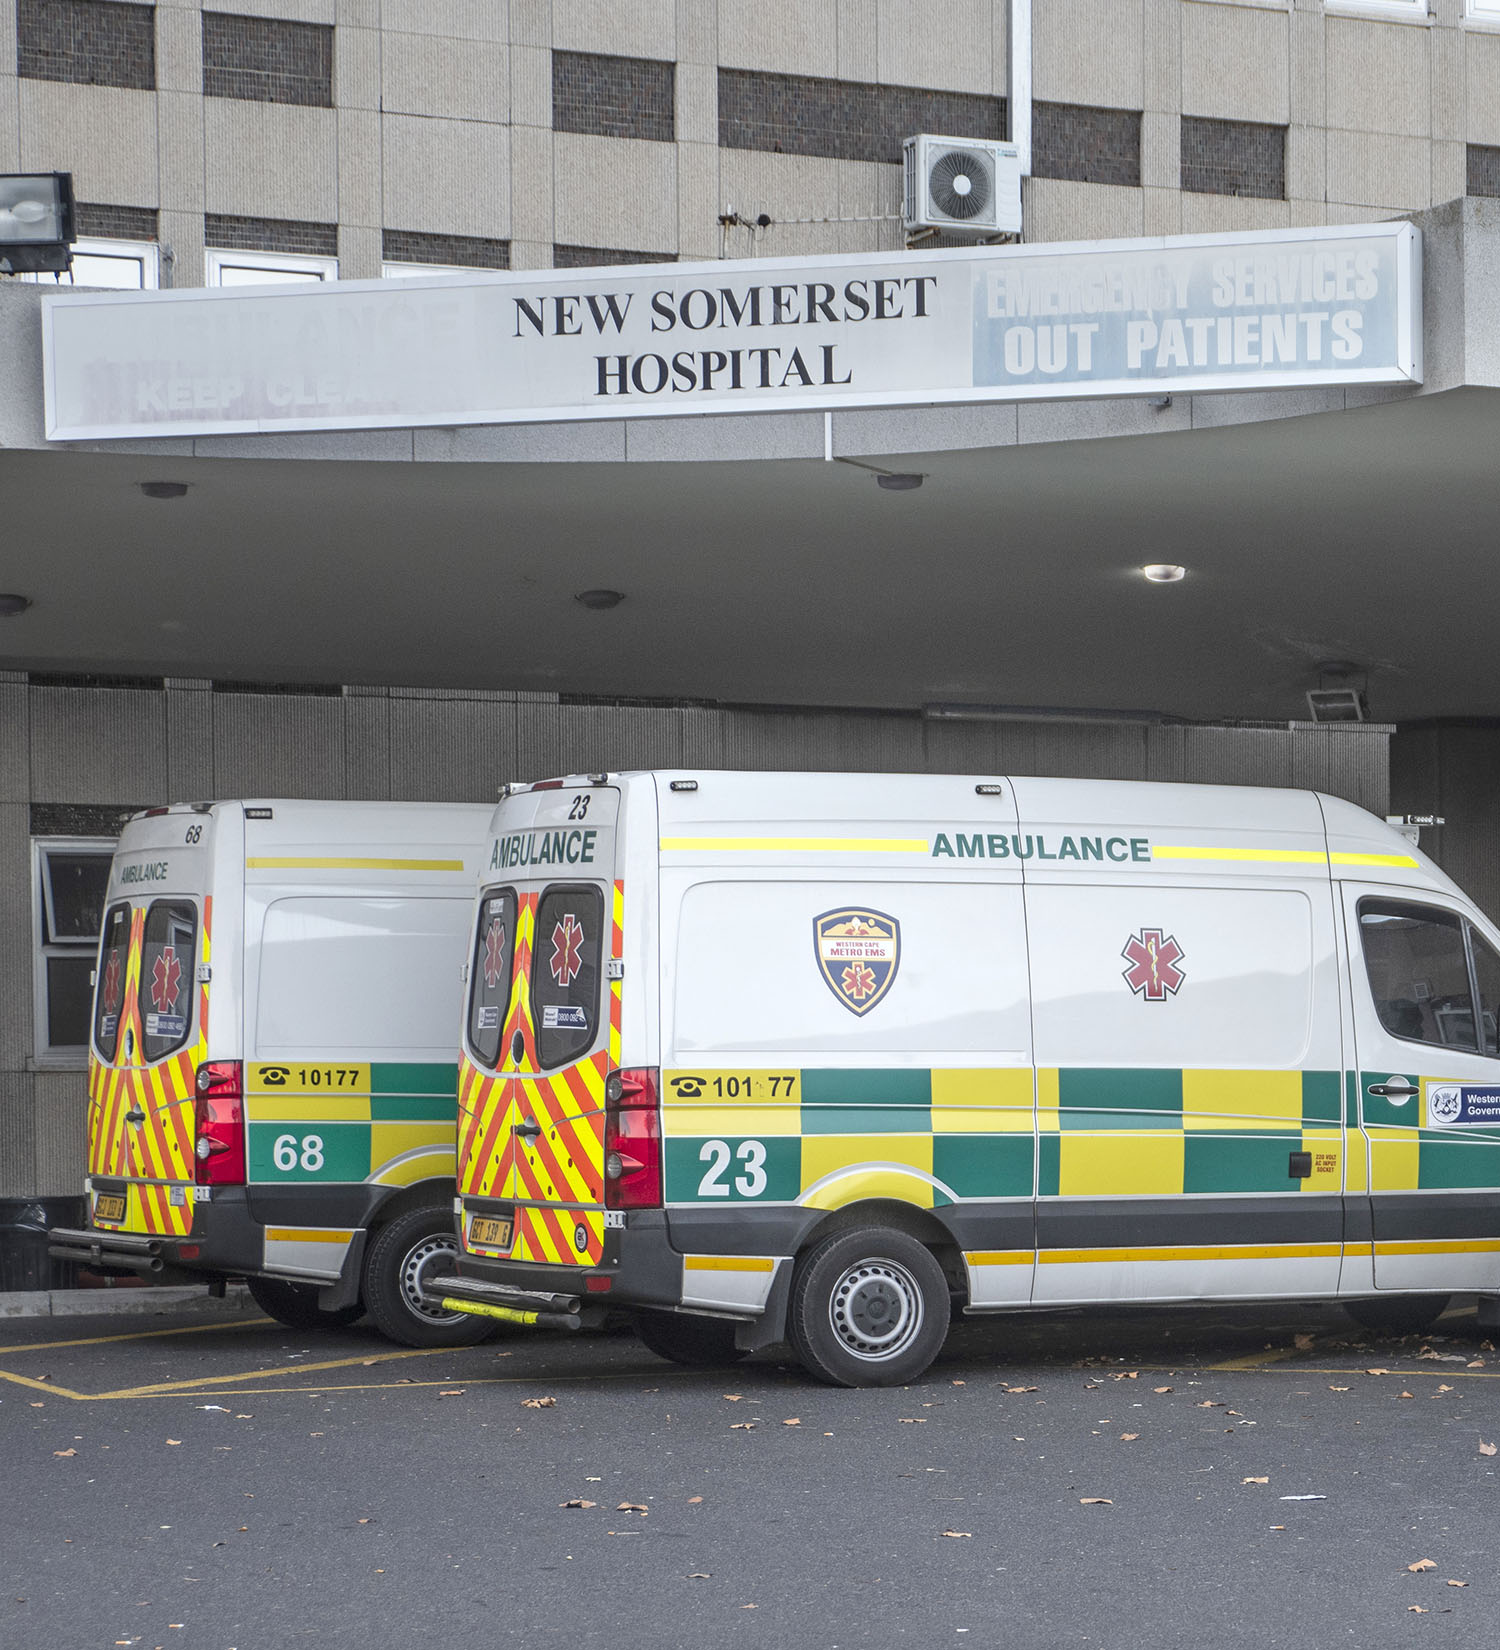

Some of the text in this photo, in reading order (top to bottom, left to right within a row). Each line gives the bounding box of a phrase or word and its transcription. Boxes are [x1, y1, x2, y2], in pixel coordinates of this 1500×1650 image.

[988, 249, 1379, 318] EMERGENCY SERVICES
[512, 276, 937, 337] NEW SOMERSET
[1004, 310, 1363, 375] OUT PATIENTS
[593, 344, 853, 396] HOSPITAL
[137, 375, 244, 412] KEEP
[568, 795, 591, 820] 23
[185, 825, 202, 844] 68
[490, 830, 597, 871] AMBULANCE
[932, 833, 1151, 862] AMBULANCE
[120, 862, 168, 884] AMBULANCE
[830, 948, 885, 957] METRO EMS
[299, 1069, 359, 1086] 10177
[273, 1134, 325, 1172] 68
[698, 1140, 767, 1197] 23
